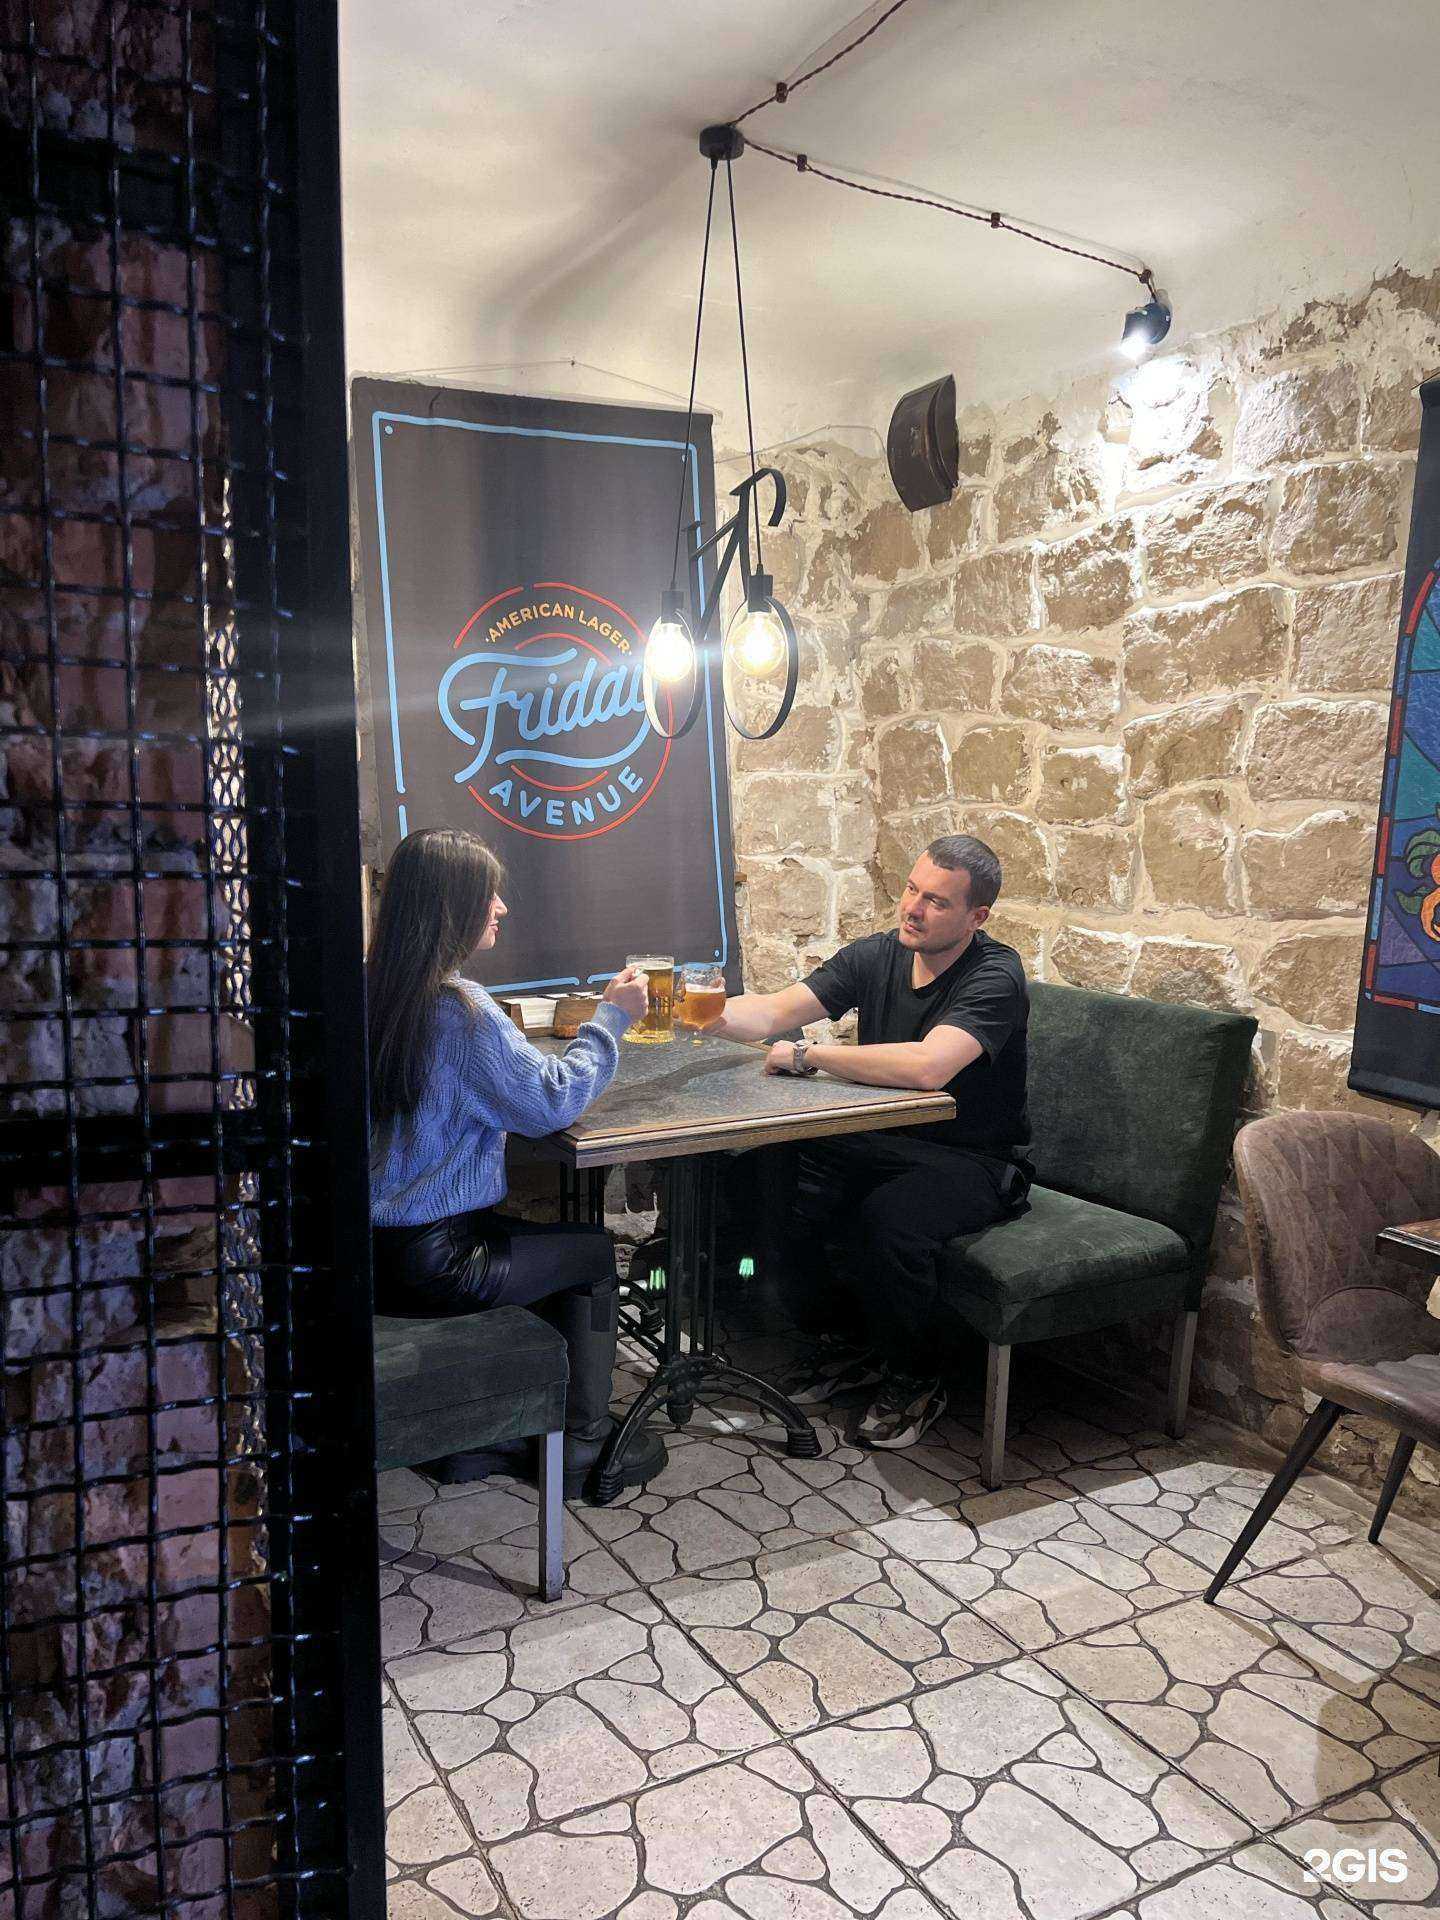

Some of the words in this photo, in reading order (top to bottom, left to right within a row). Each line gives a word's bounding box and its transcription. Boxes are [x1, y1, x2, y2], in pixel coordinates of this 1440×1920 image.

[488, 602, 575, 643] AMERICAN
[578, 609, 631, 654] LAGER
[489, 765, 645, 826] AVENUE
